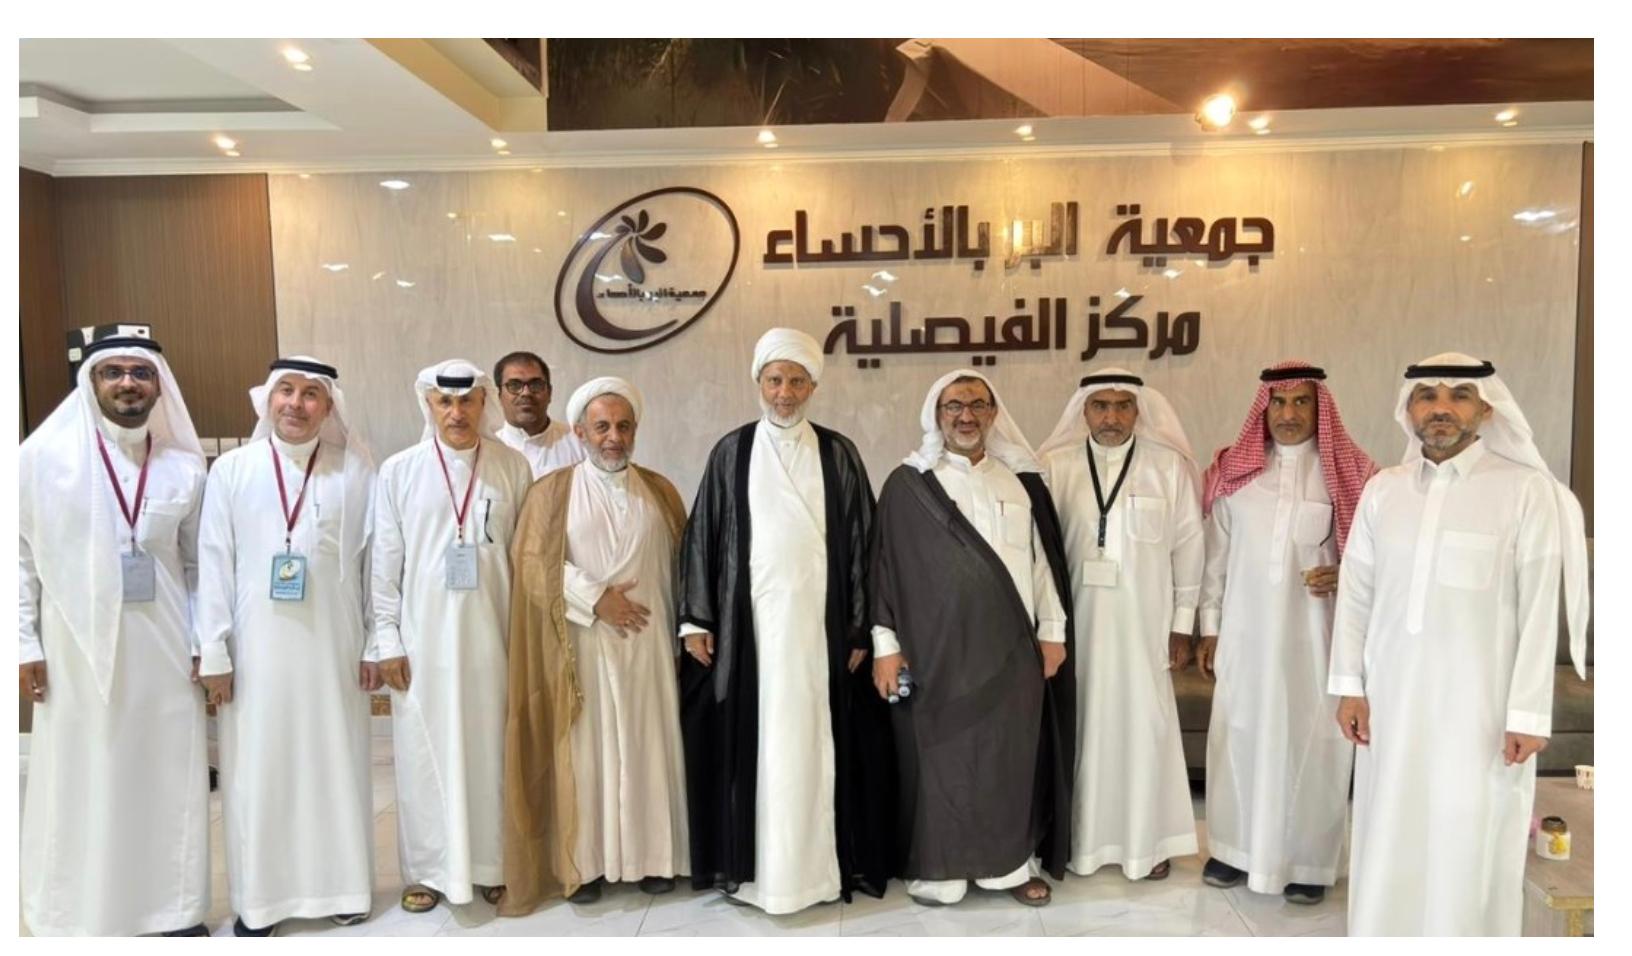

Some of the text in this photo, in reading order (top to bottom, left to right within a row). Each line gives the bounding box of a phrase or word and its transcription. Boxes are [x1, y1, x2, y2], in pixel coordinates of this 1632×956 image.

[762, 200, 1275, 271] جمعية البر بالأحساء
[822, 294, 1201, 369] مركز الفيصلية
